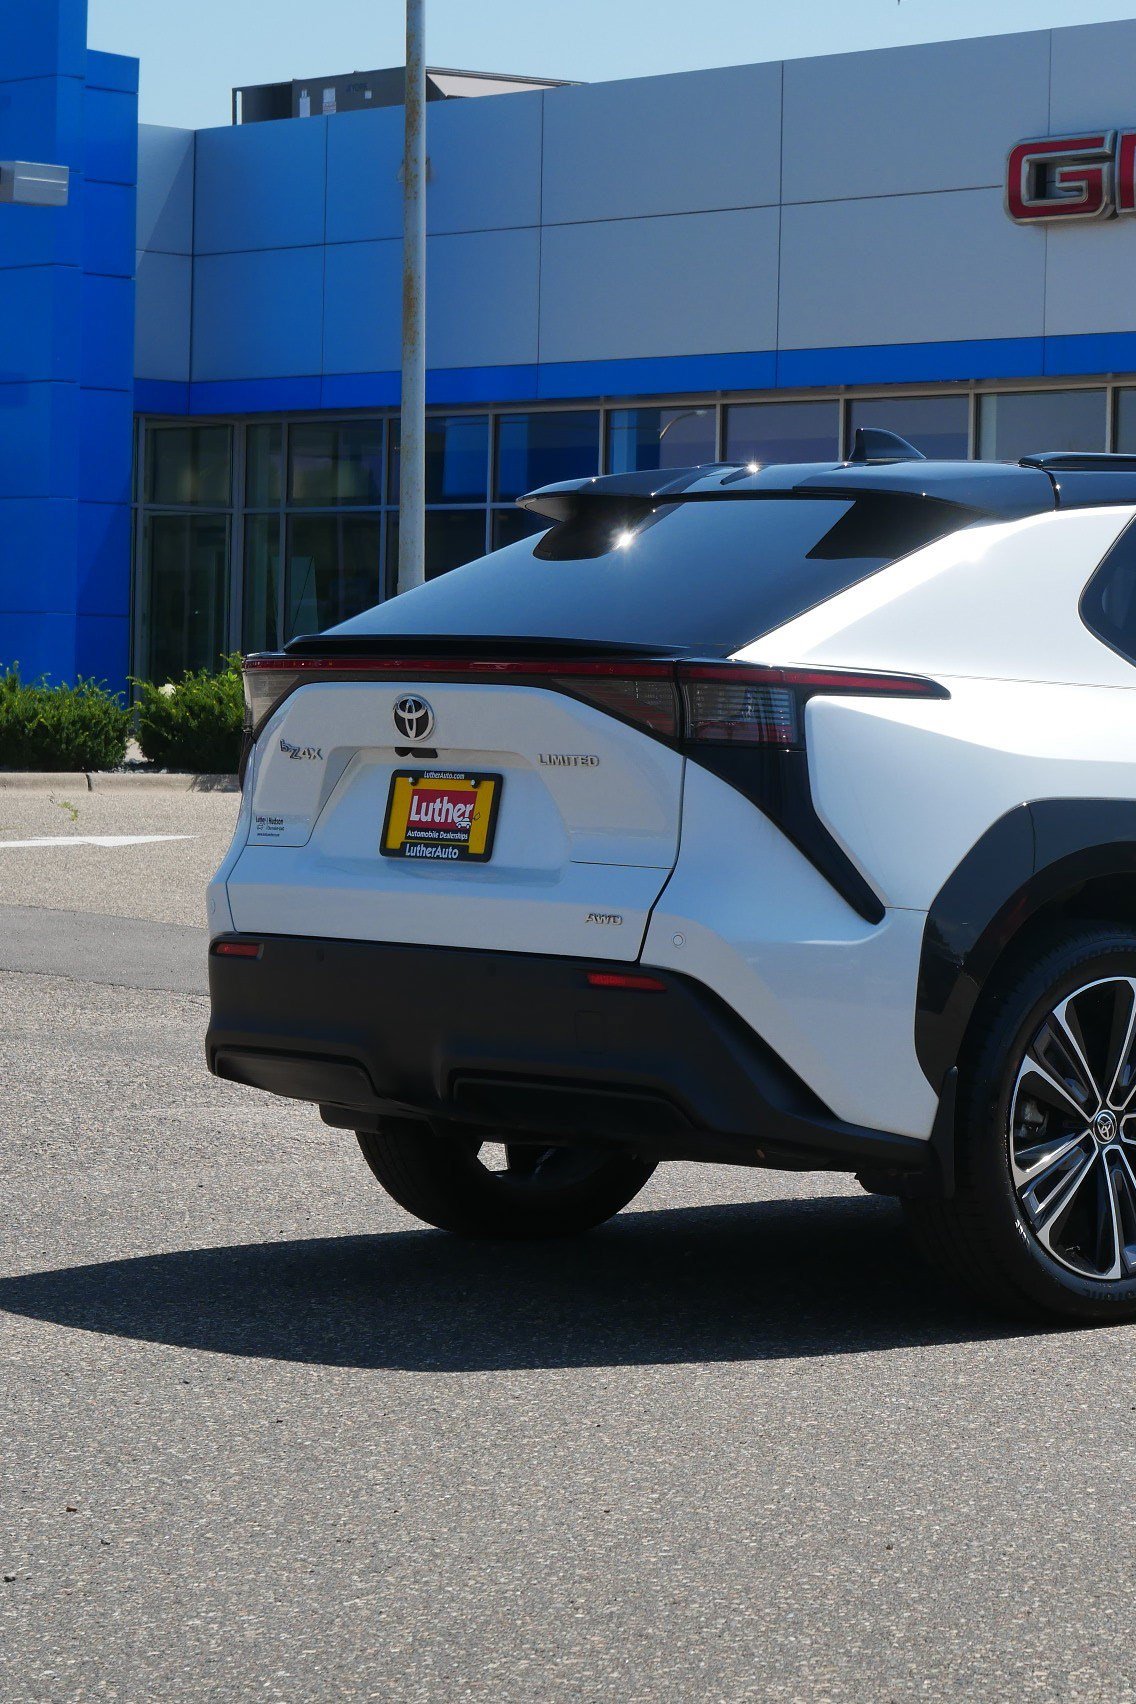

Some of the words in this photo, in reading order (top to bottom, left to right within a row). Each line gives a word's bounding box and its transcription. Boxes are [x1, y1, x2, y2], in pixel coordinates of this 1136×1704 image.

[537, 753, 600, 767] LIMITED
[423, 771, 465, 780] LutherAuto.com
[409, 795, 475, 823] Luther
[406, 830, 439, 839] Automobile
[440, 831, 468, 840] Dealerships
[405, 843, 459, 859] LutherAuto
[585, 912, 623, 926] AWD
